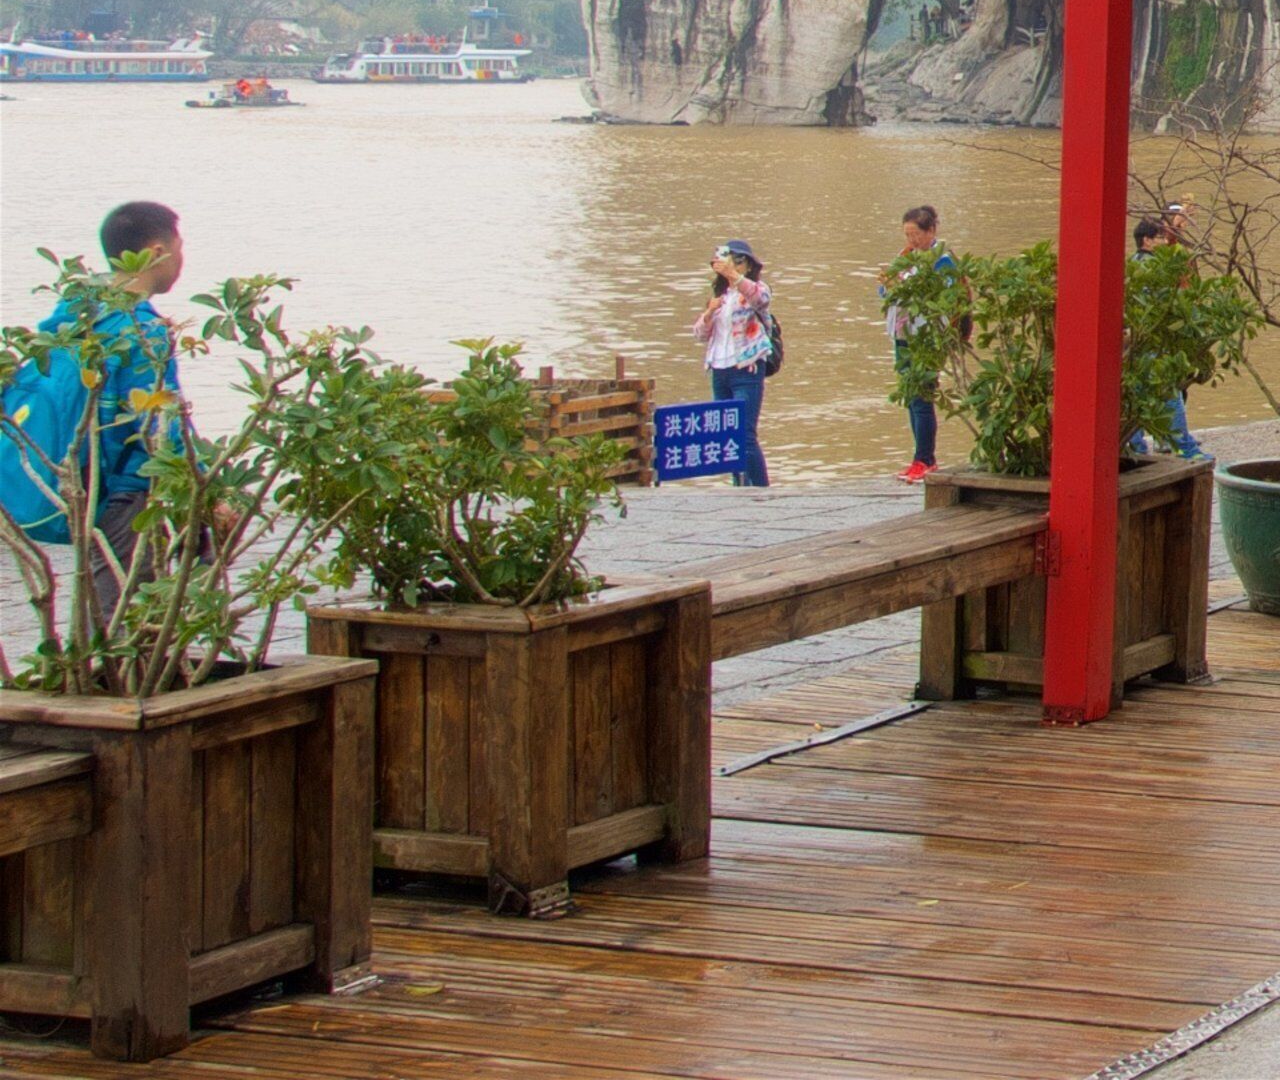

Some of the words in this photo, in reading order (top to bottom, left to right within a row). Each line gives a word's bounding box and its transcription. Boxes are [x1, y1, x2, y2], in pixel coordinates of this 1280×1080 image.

[664, 407, 739, 437] 洪水期间
[664, 439, 740, 470] 注意安全
